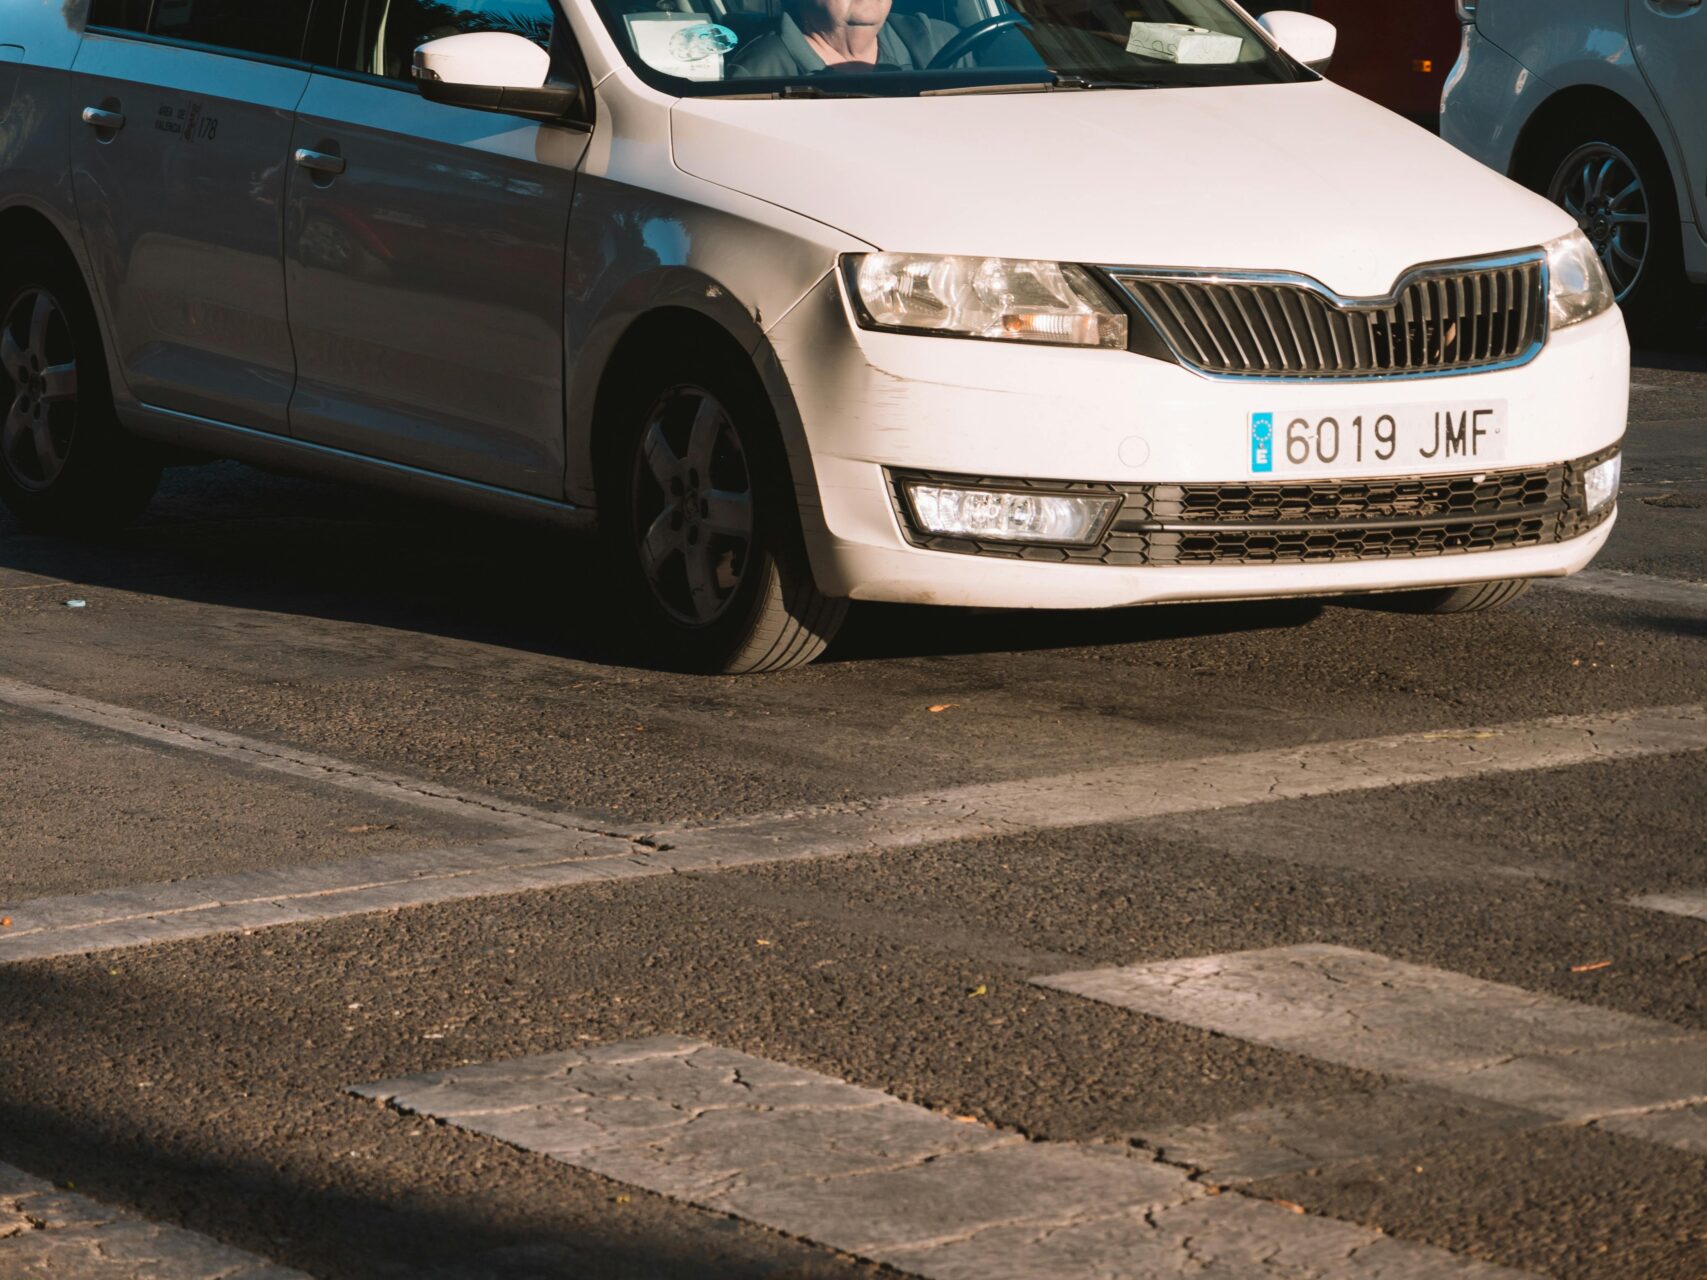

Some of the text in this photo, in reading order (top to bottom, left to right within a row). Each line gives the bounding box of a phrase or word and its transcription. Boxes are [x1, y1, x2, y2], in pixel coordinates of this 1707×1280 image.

[198, 117, 219, 140] 178
[1286, 409, 1494, 465] 6019 JMF
[1256, 448, 1268, 464] E
